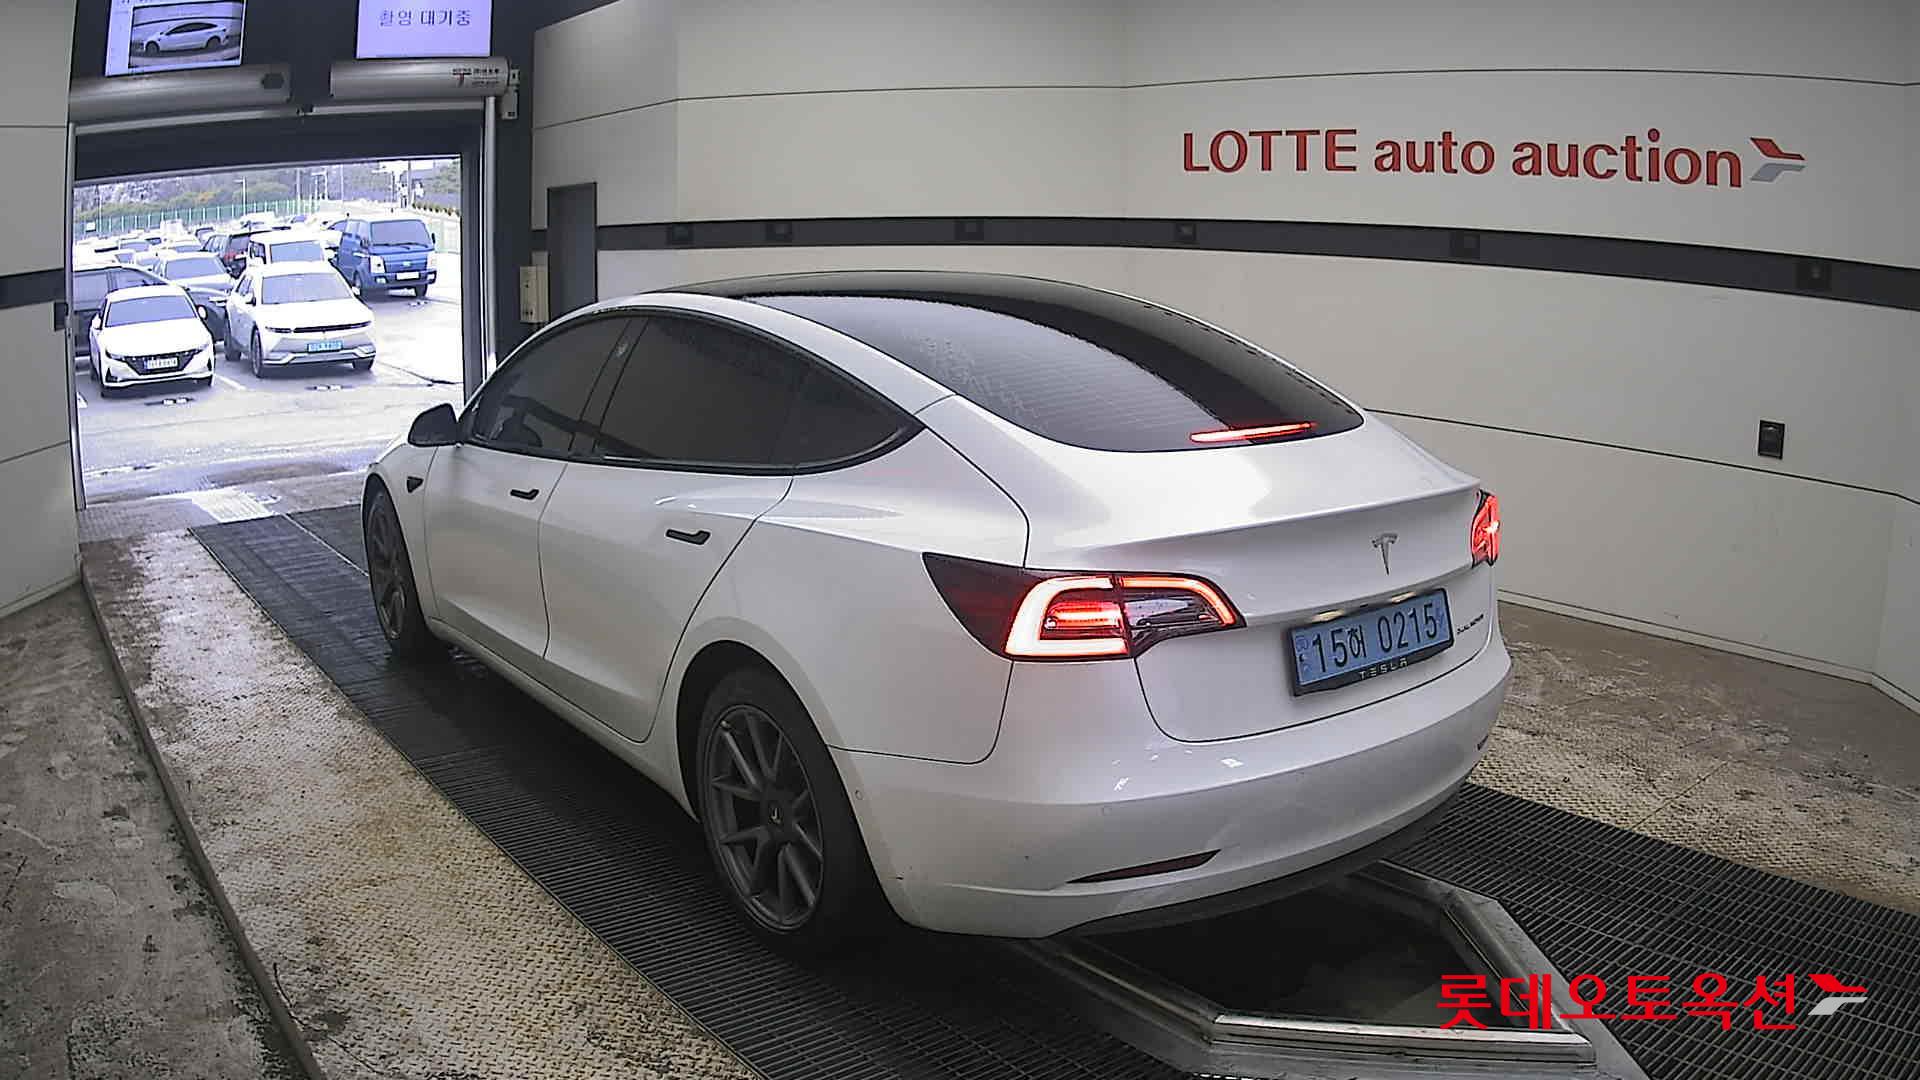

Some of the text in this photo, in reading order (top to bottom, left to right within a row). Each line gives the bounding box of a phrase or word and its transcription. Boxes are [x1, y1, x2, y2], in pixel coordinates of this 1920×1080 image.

[1183, 127, 1743, 189] LOTTE auto auction
[1377, 603, 1438, 653] 0215
[1359, 657, 1409, 680] TESLA
